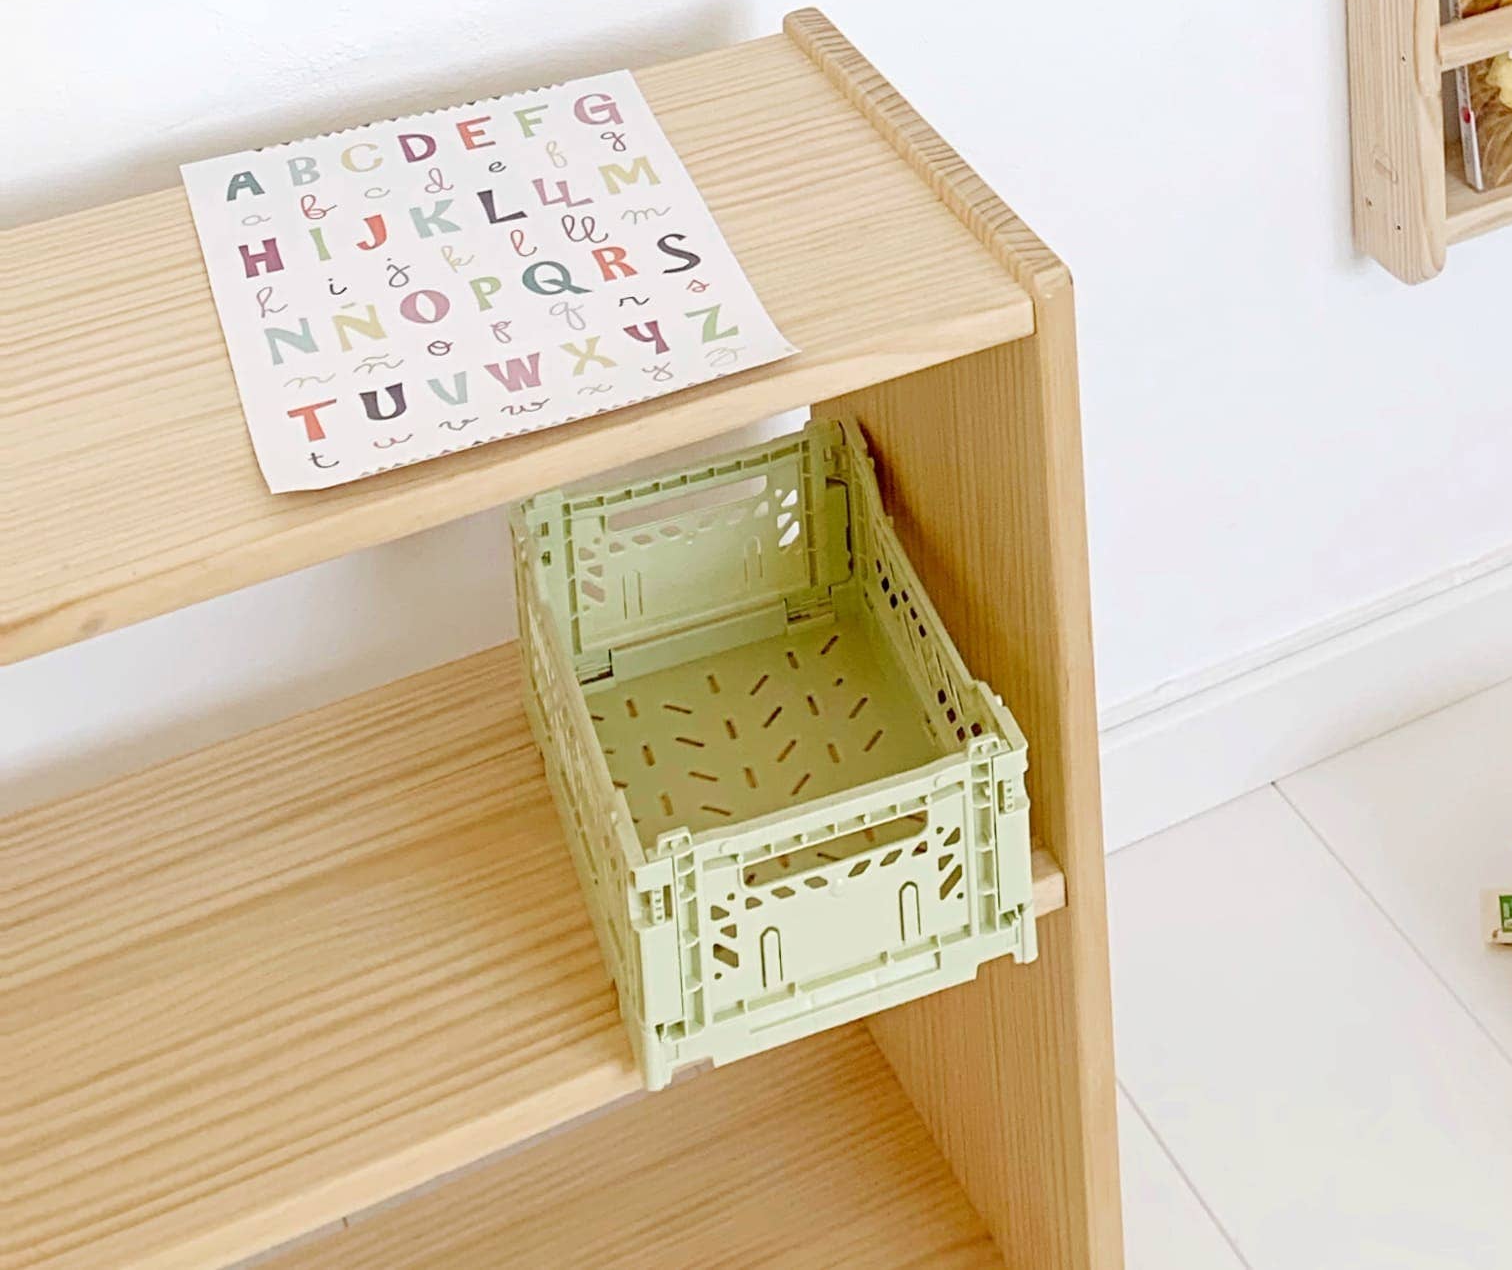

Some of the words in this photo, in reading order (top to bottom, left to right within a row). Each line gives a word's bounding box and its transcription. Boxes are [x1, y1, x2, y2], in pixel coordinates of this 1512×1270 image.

[227, 170, 265, 202] A
[287, 157, 320, 187] B
[341, 143, 383, 173] C
[397, 133, 437, 163] D
[456, 116, 496, 150] E
[514, 104, 549, 138] F
[574, 93, 625, 126] G
[238, 237, 284, 279] H
[309, 227, 332, 261] I
[356, 214, 388, 251] J
[409, 199, 461, 238] K
[476, 189, 528, 224] L
[532, 178, 593, 208] LL
[598, 156, 661, 194] M
[264, 318, 319, 365] N
[332, 302, 387, 352] Ñ
[400, 290, 450, 324] O
[469, 276, 502, 312] P
[522, 261, 593, 295] Q
[591, 246, 638, 282] R
[656, 232, 701, 274] S
[287, 399, 337, 442] T
[358, 382, 407, 421] U
[427, 371, 468, 405] V
[484, 352, 541, 392] W
[560, 336, 617, 377] X
[623, 320, 670, 355] Y
[684, 304, 739, 344] Z
